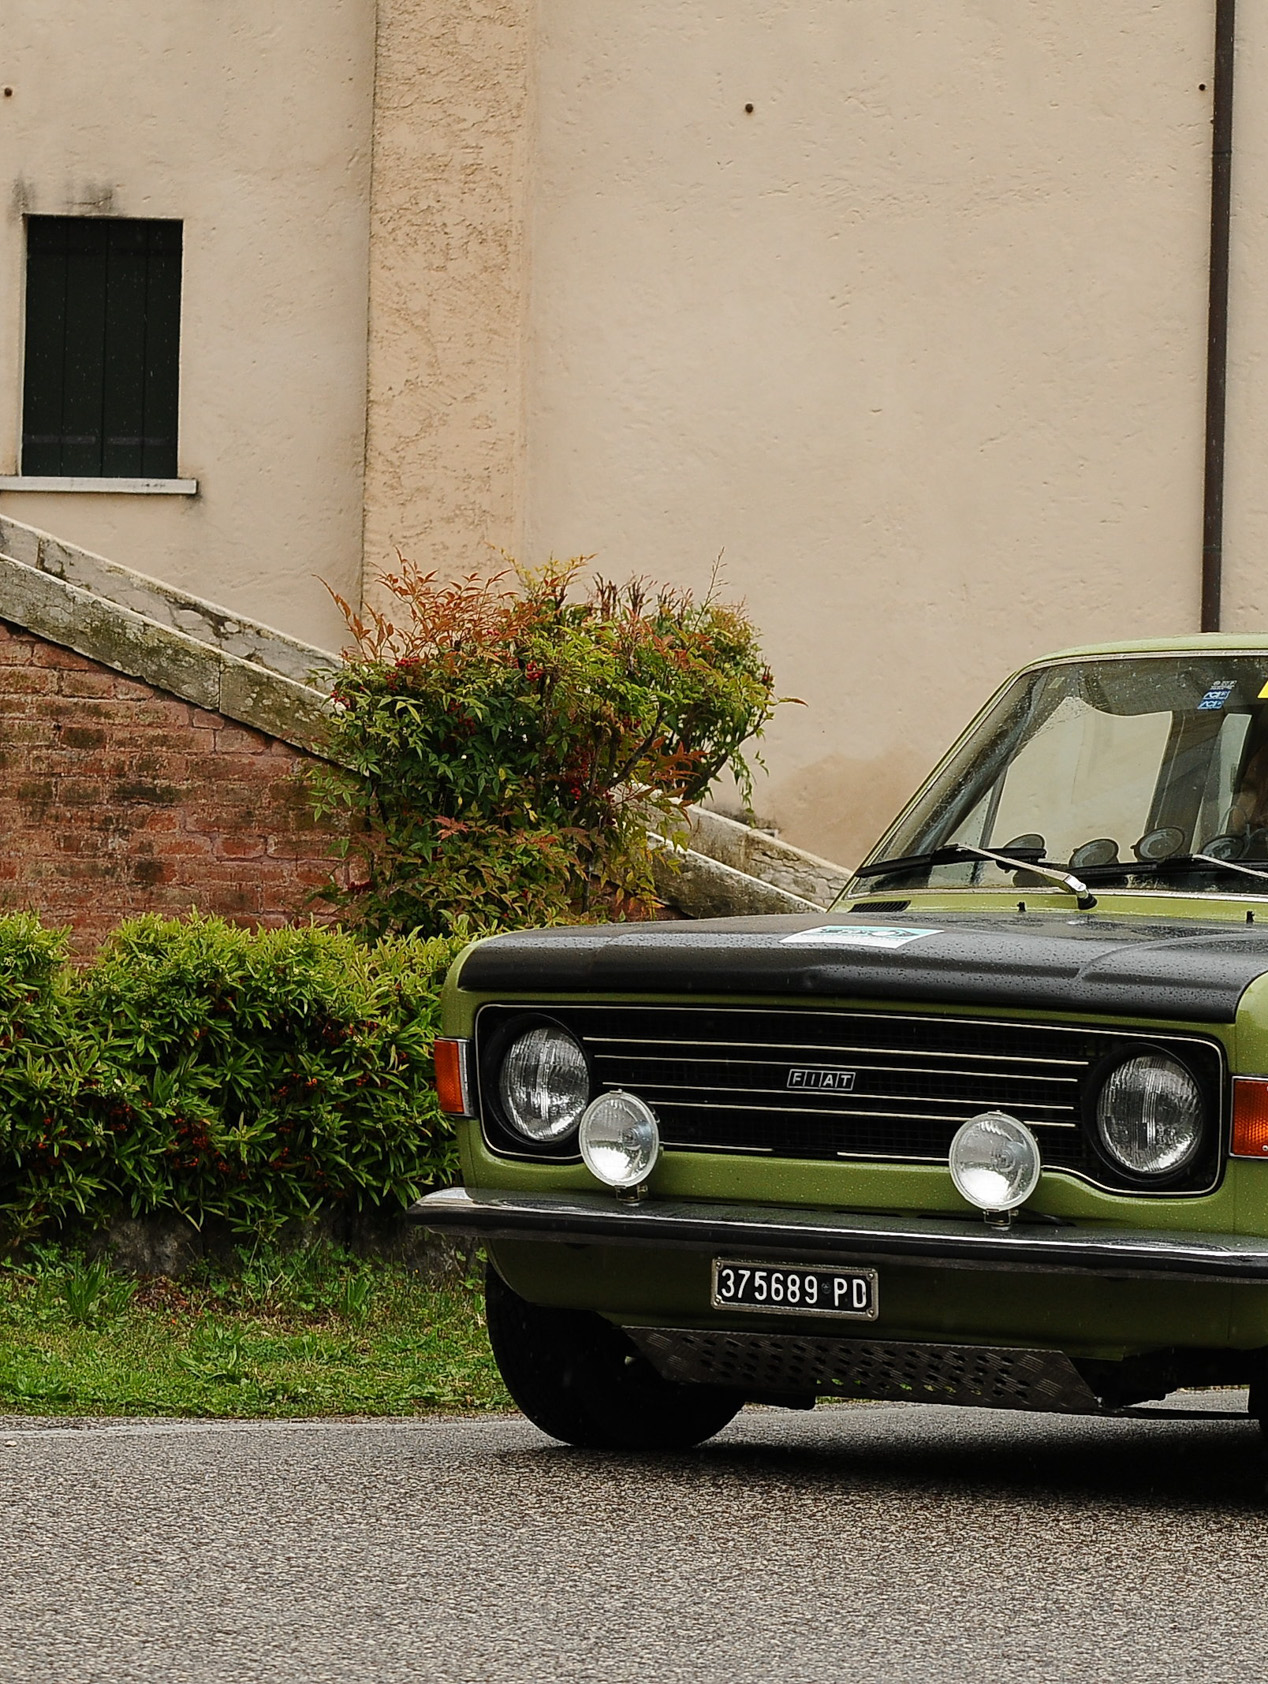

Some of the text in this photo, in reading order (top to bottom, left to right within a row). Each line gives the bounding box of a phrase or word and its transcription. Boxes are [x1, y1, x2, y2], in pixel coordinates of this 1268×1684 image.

[792, 1072, 852, 1087] FIAT
[721, 1268, 867, 1308] 375689 PD
